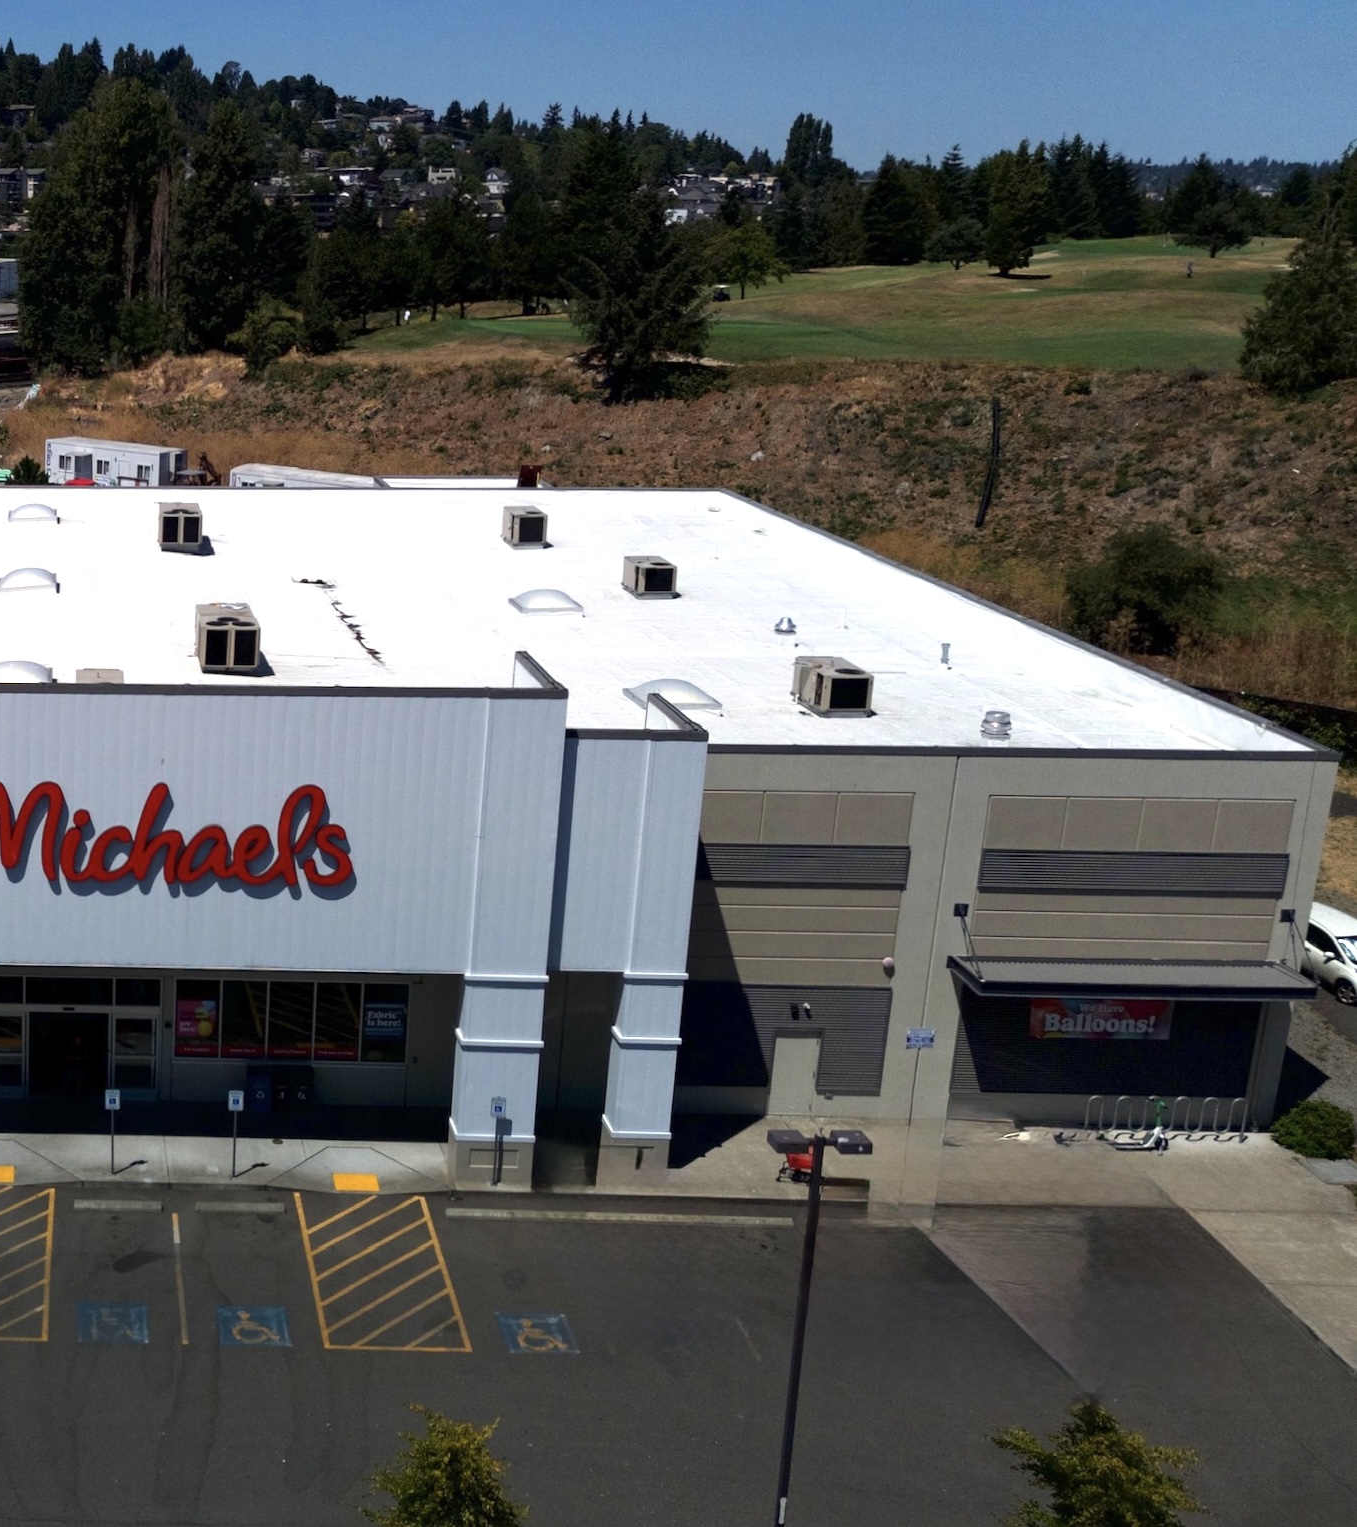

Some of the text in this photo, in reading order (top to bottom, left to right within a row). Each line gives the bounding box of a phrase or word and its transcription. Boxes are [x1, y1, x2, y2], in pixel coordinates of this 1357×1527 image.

[1080, 1004, 1125, 1013] We Have
[367, 1010, 397, 1019] Fabric
[367, 1018, 402, 1027] is here!
[1044, 1013, 1156, 1033] Balloons!
